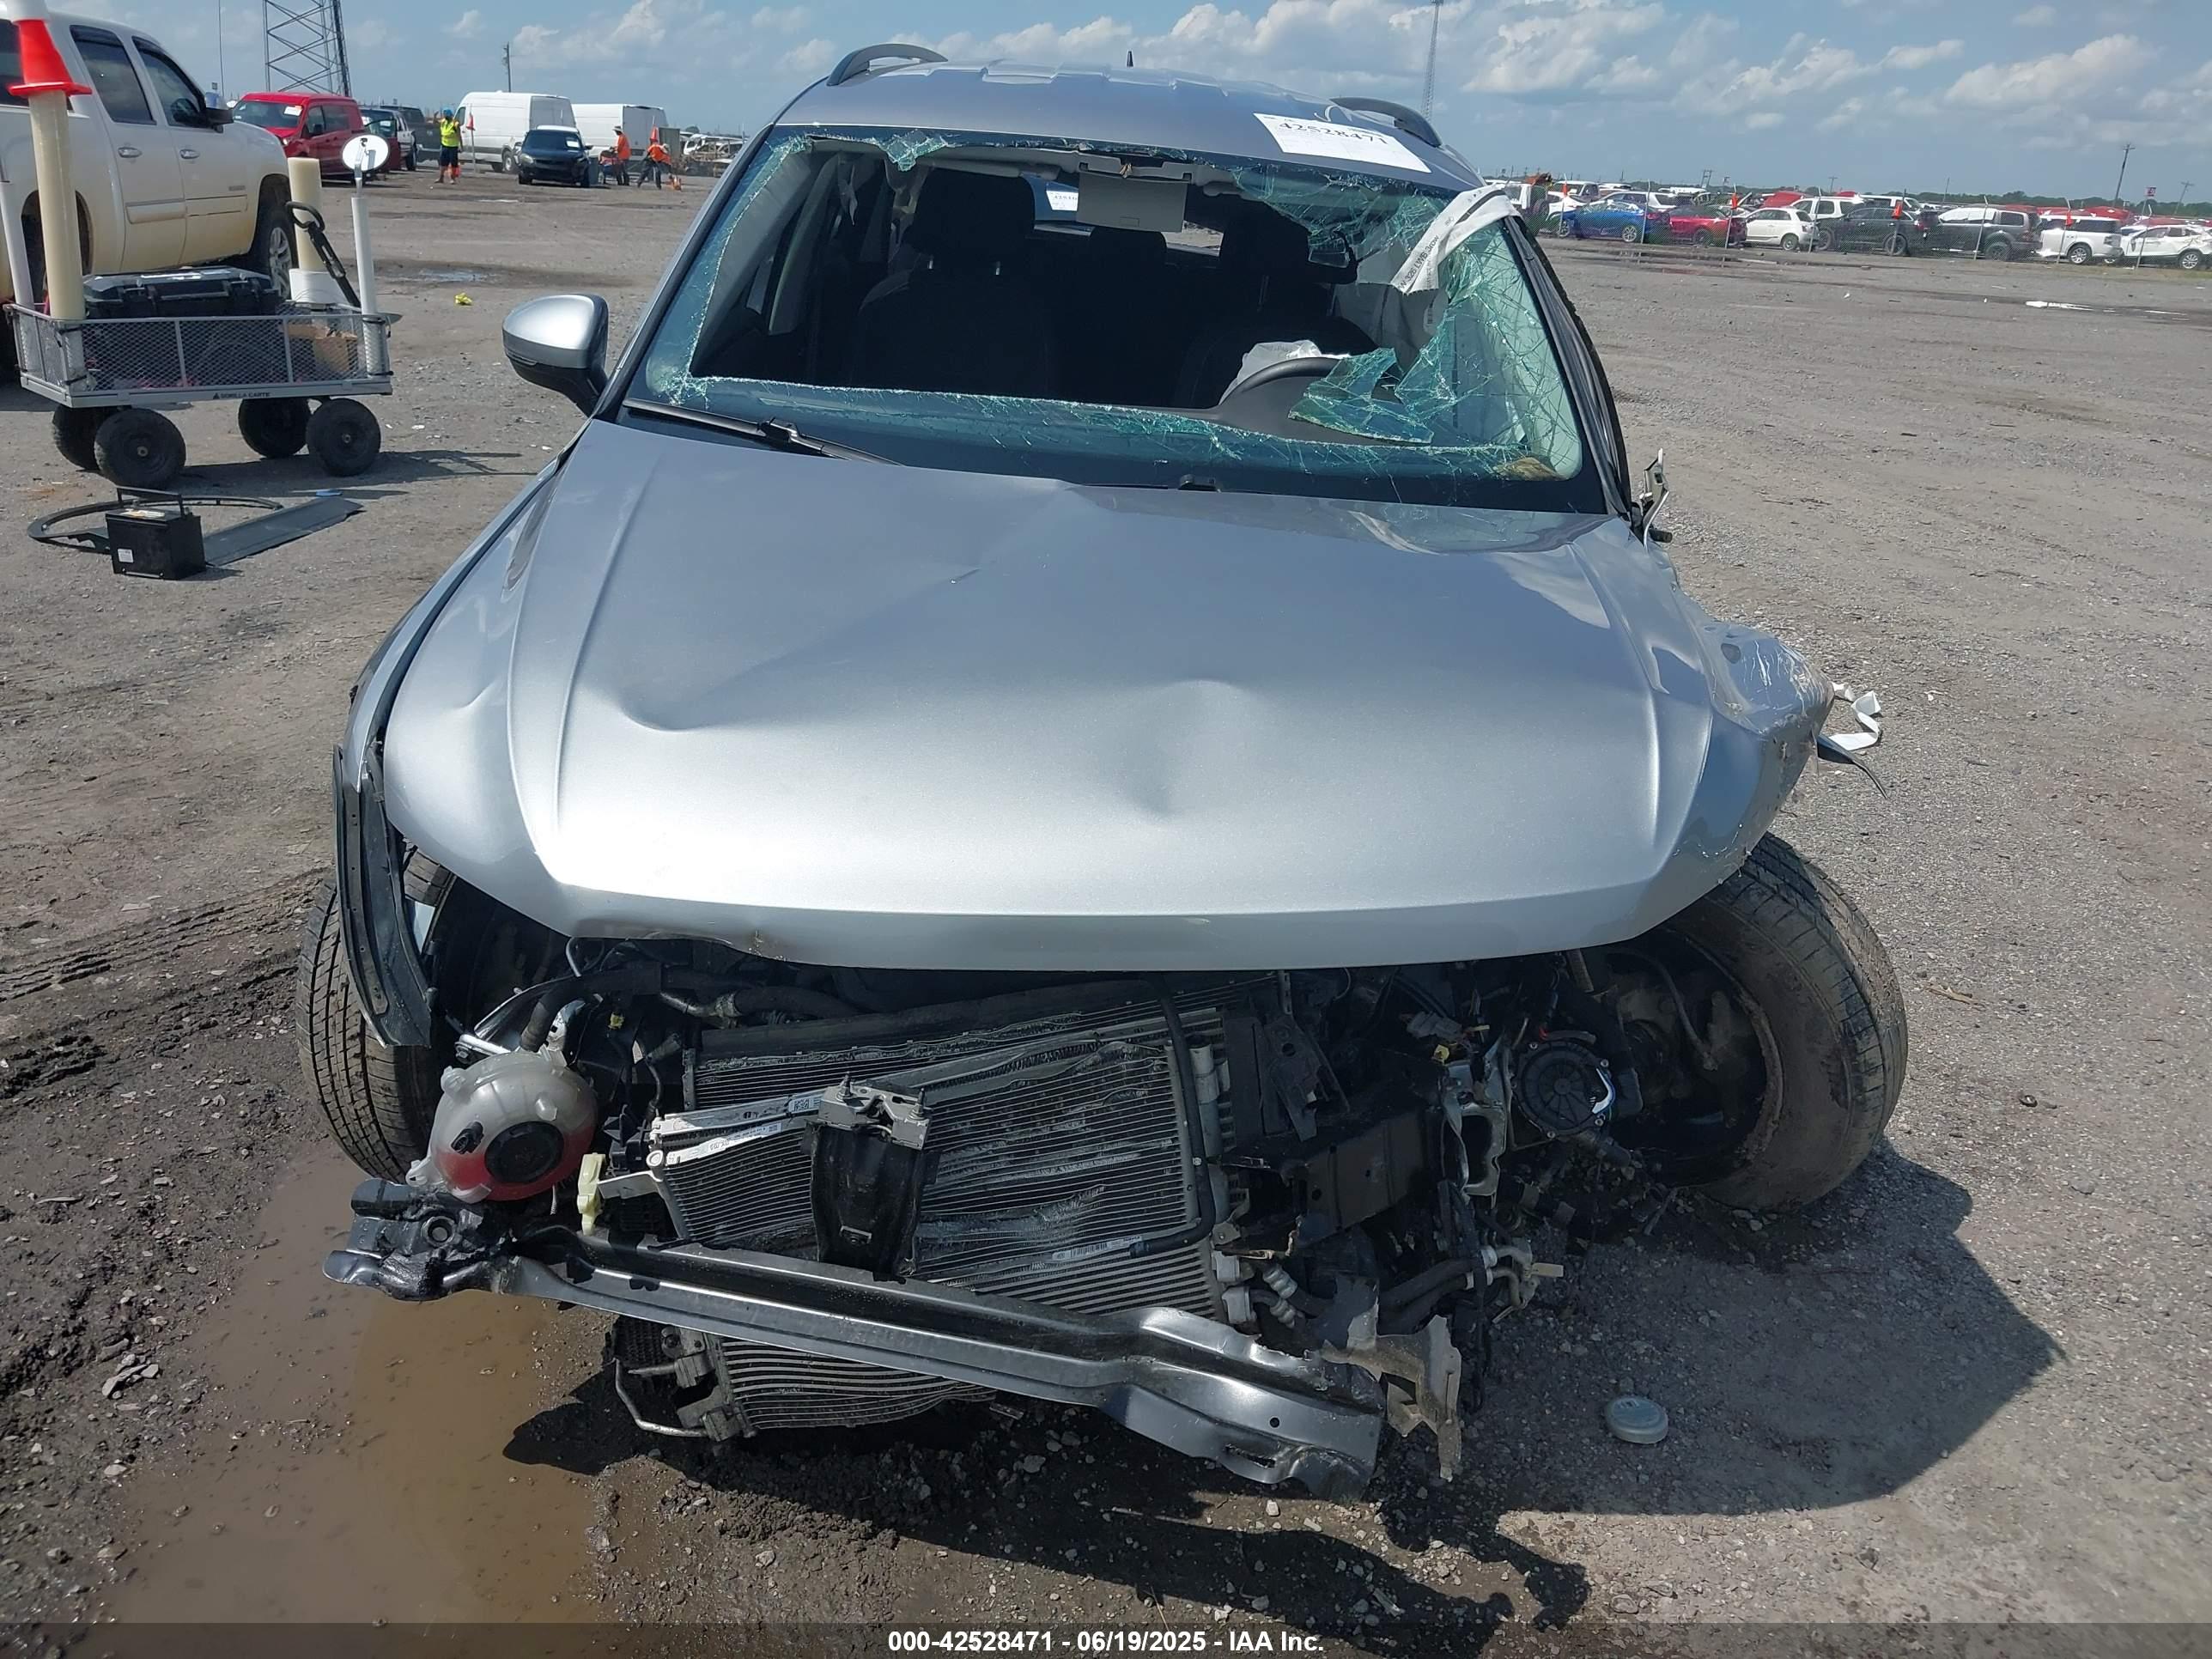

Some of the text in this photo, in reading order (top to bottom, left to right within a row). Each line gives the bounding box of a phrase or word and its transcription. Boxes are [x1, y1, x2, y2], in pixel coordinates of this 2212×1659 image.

[1279, 122, 1389, 145] 42528471
[1406, 267, 1417, 282] 326
[1413, 252, 1428, 269] LWB
[1425, 234, 1439, 252] 3row
